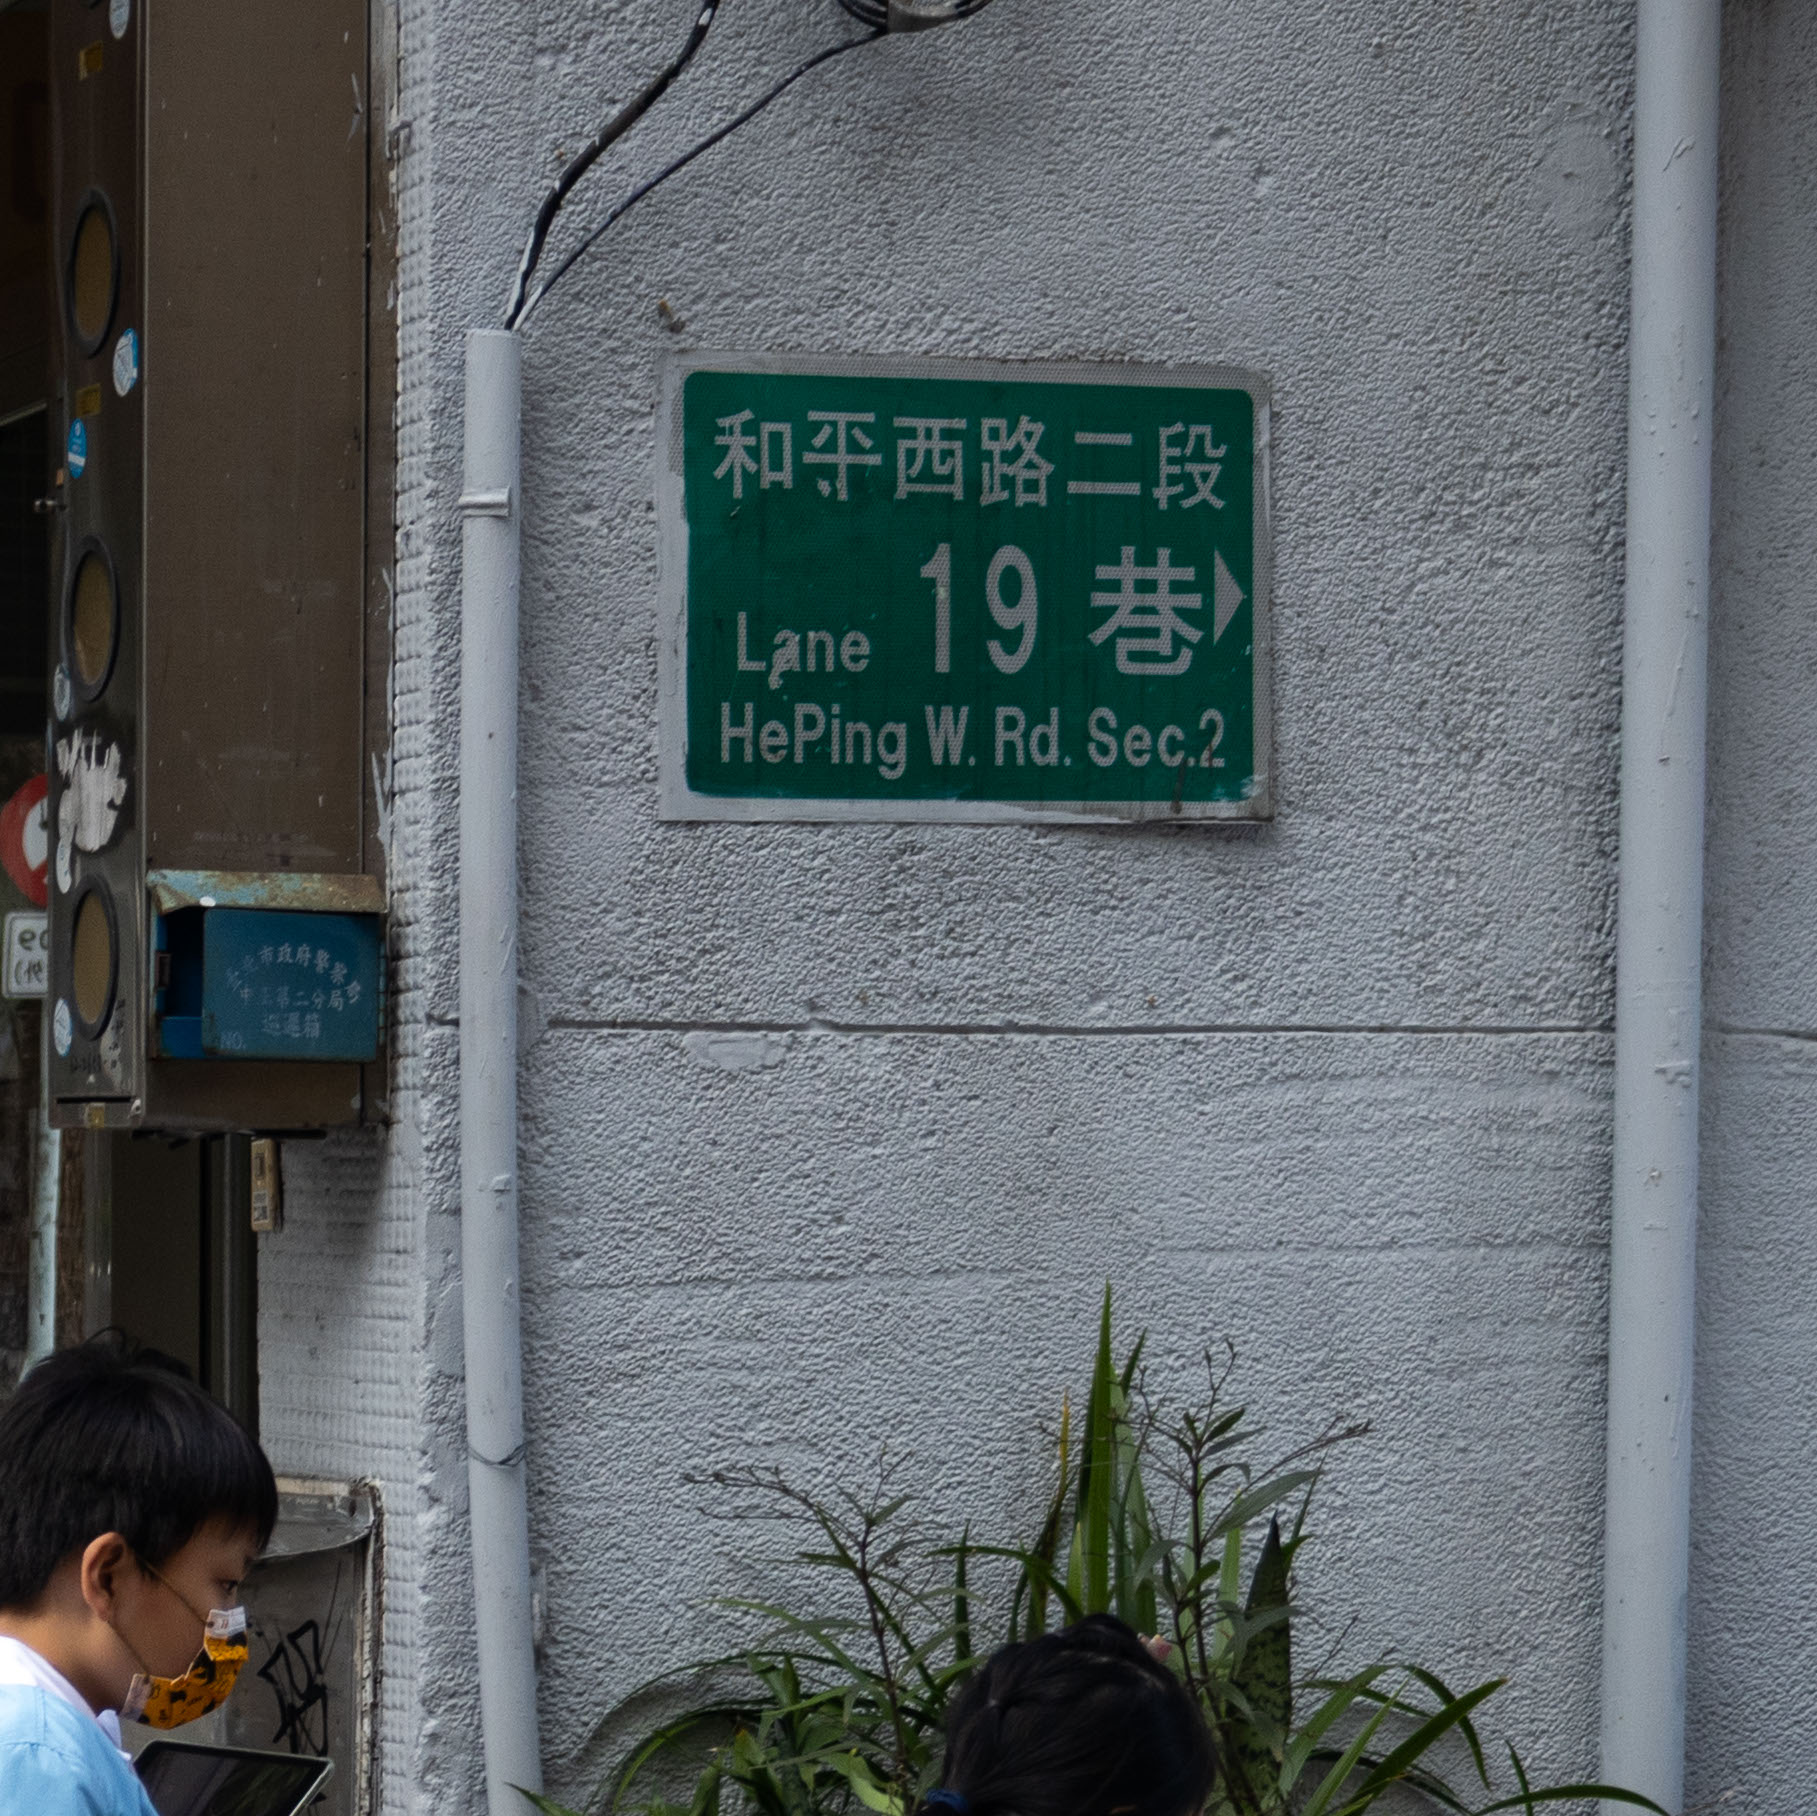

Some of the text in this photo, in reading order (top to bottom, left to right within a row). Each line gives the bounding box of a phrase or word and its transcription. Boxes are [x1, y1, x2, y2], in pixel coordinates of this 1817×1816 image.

[712, 408, 1227, 510] 和平西路二段
[736, 610, 872, 690] Lane
[720, 701, 908, 780] HePing
[994, 706, 1071, 767] Rd.
